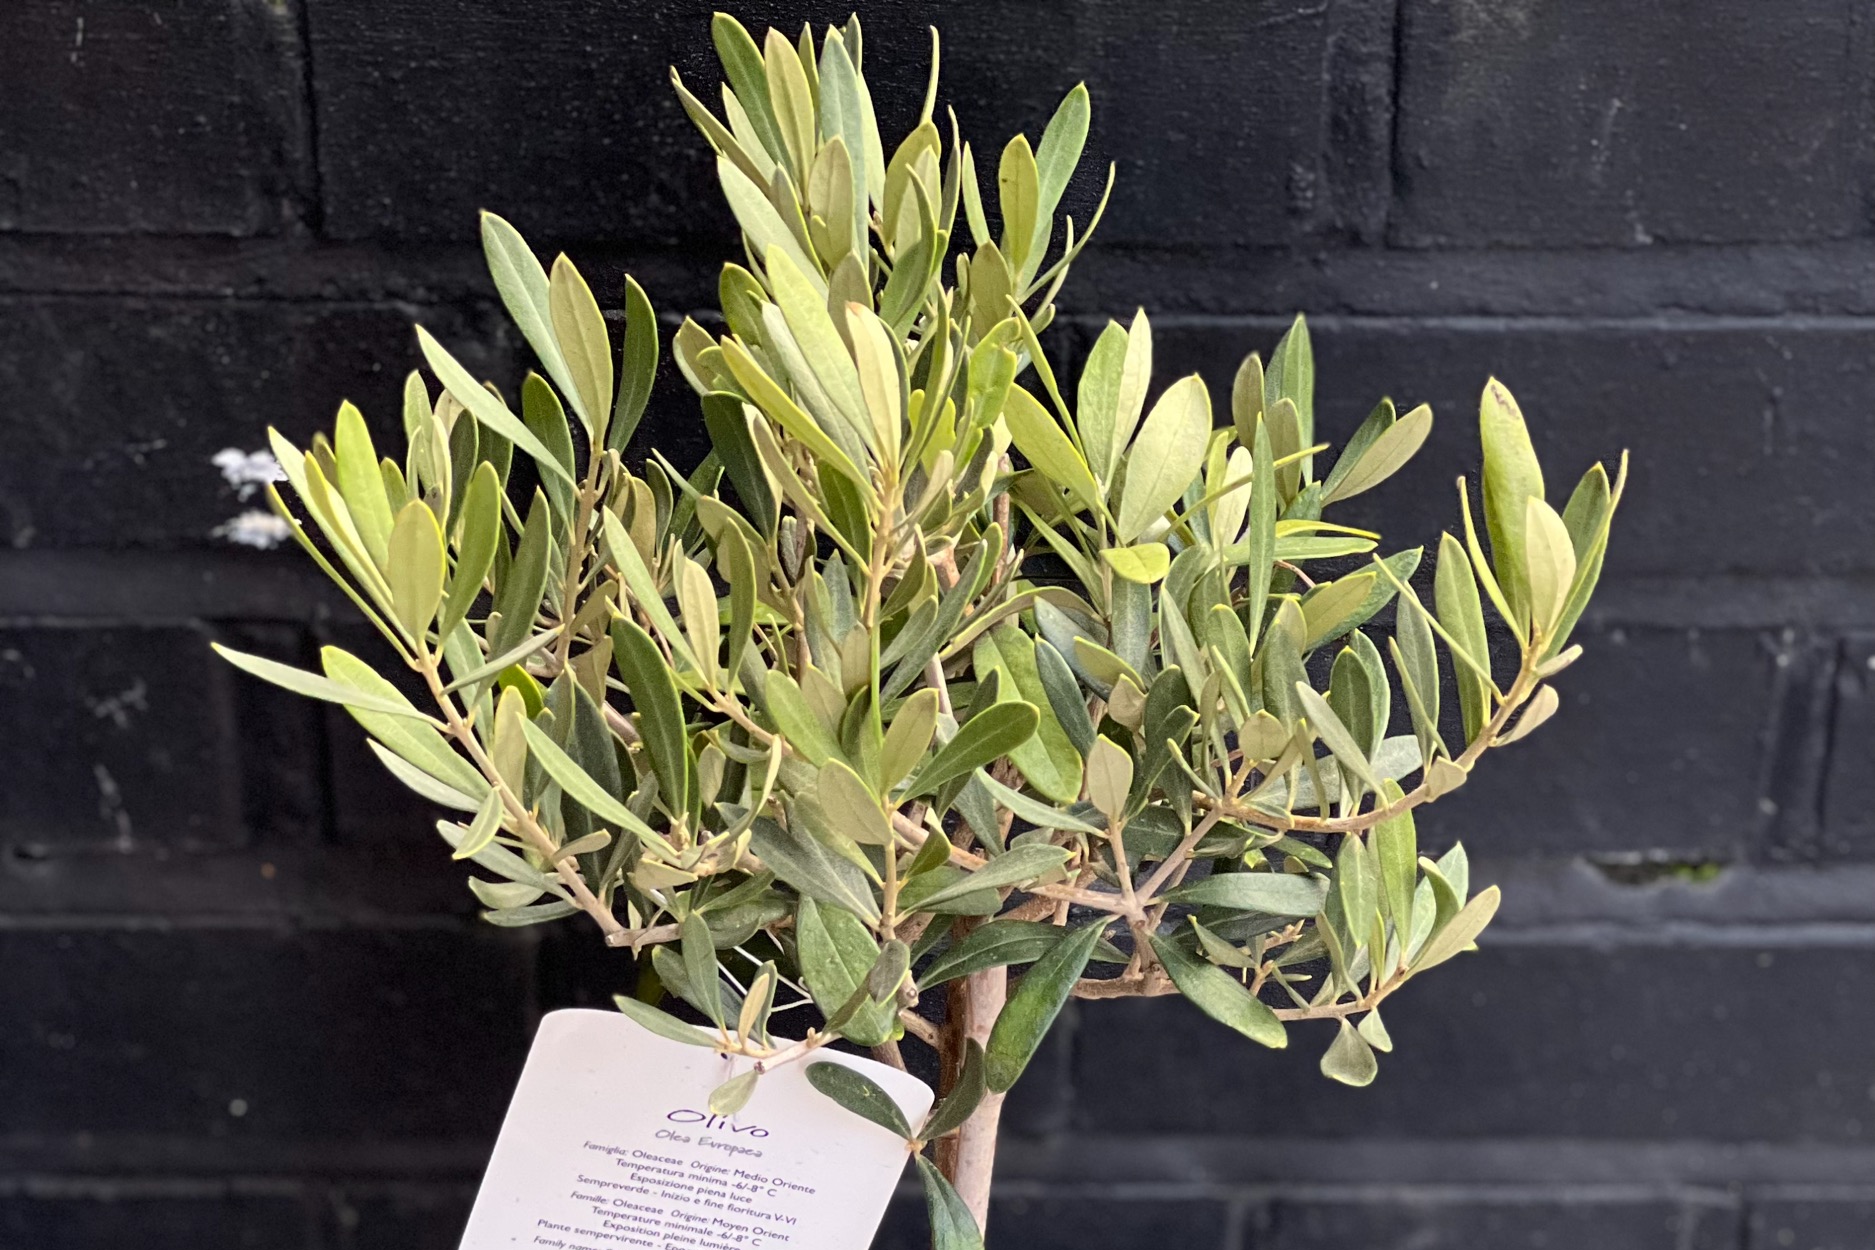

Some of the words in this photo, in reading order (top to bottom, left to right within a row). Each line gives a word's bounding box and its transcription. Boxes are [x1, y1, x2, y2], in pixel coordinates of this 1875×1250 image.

[655, 1129, 691, 1143] Olea
[666, 1109, 769, 1138] Olivo
[616, 1158, 685, 1178] Temperatura
[688, 1174, 728, 1187] minima
[767, 1189, 777, 1197] C
[630, 1172, 694, 1191] Esposizione
[696, 1187, 726, 1198] piena
[730, 1192, 752, 1203] luce
[632, 1150, 683, 1166] Oleaceae
[733, 1169, 768, 1186] Medio
[772, 1178, 816, 1194] Oriente
[577, 1174, 649, 1195] Sempreverde
[661, 1190, 690, 1202] Inizio
[704, 1199, 724, 1210] fine
[727, 1203, 771, 1220] fioritura
[538, 1219, 571, 1232] Plante
[574, 1228, 653, 1247] sempervirente
[592, 1206, 661, 1226] Temperature
[664, 1222, 714, 1236] minimale
[752, 1238, 762, 1246] C
[603, 1219, 660, 1237] Exposition
[662, 1232, 696, 1245] pleine
[613, 1198, 664, 1215] Oleaceae
[712, 1217, 749, 1232] Moyen
[752, 1226, 790, 1241] Orient
[534, 1236, 566, 1250] Family
